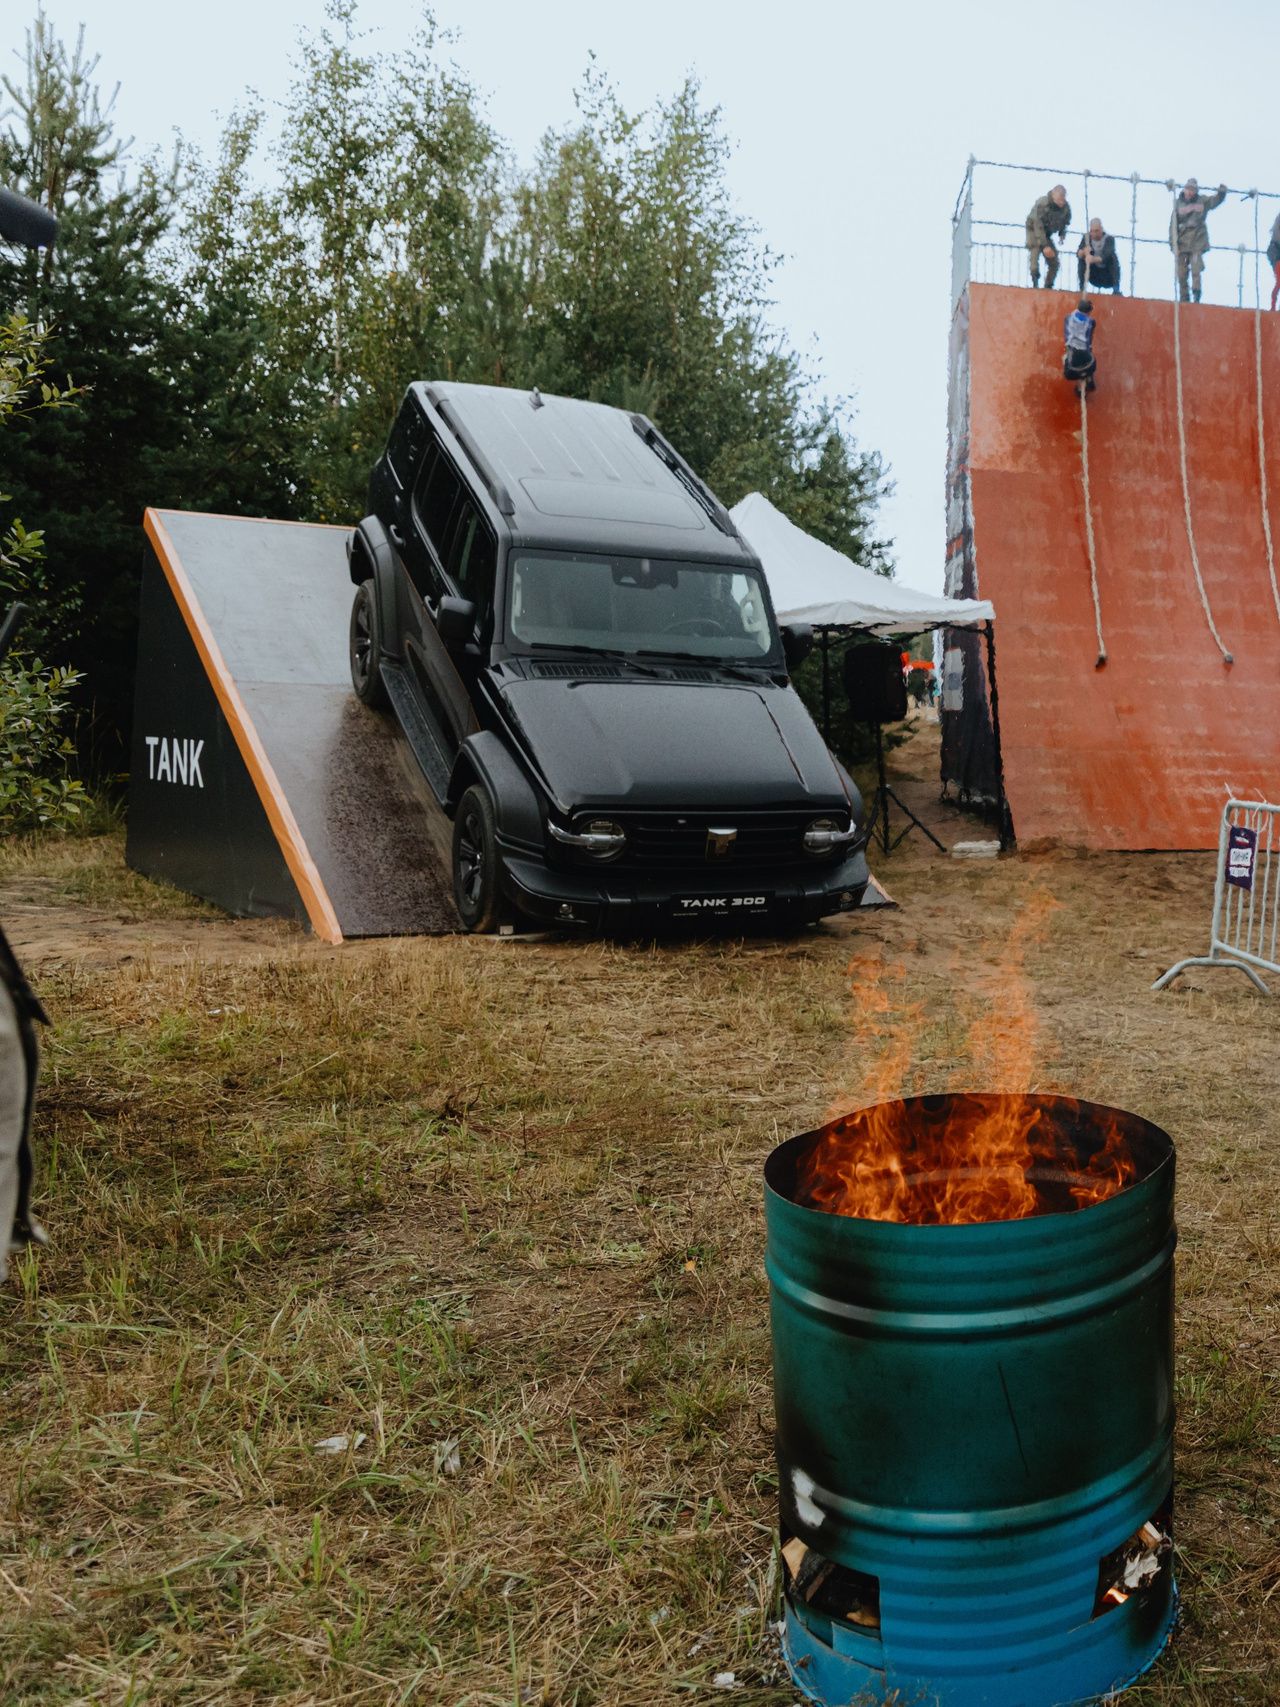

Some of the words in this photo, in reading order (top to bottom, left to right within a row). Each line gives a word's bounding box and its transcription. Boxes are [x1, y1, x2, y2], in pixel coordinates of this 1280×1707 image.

[145, 736, 205, 788] TANK
[681, 898, 728, 908] TANK
[731, 897, 766, 906] 300
